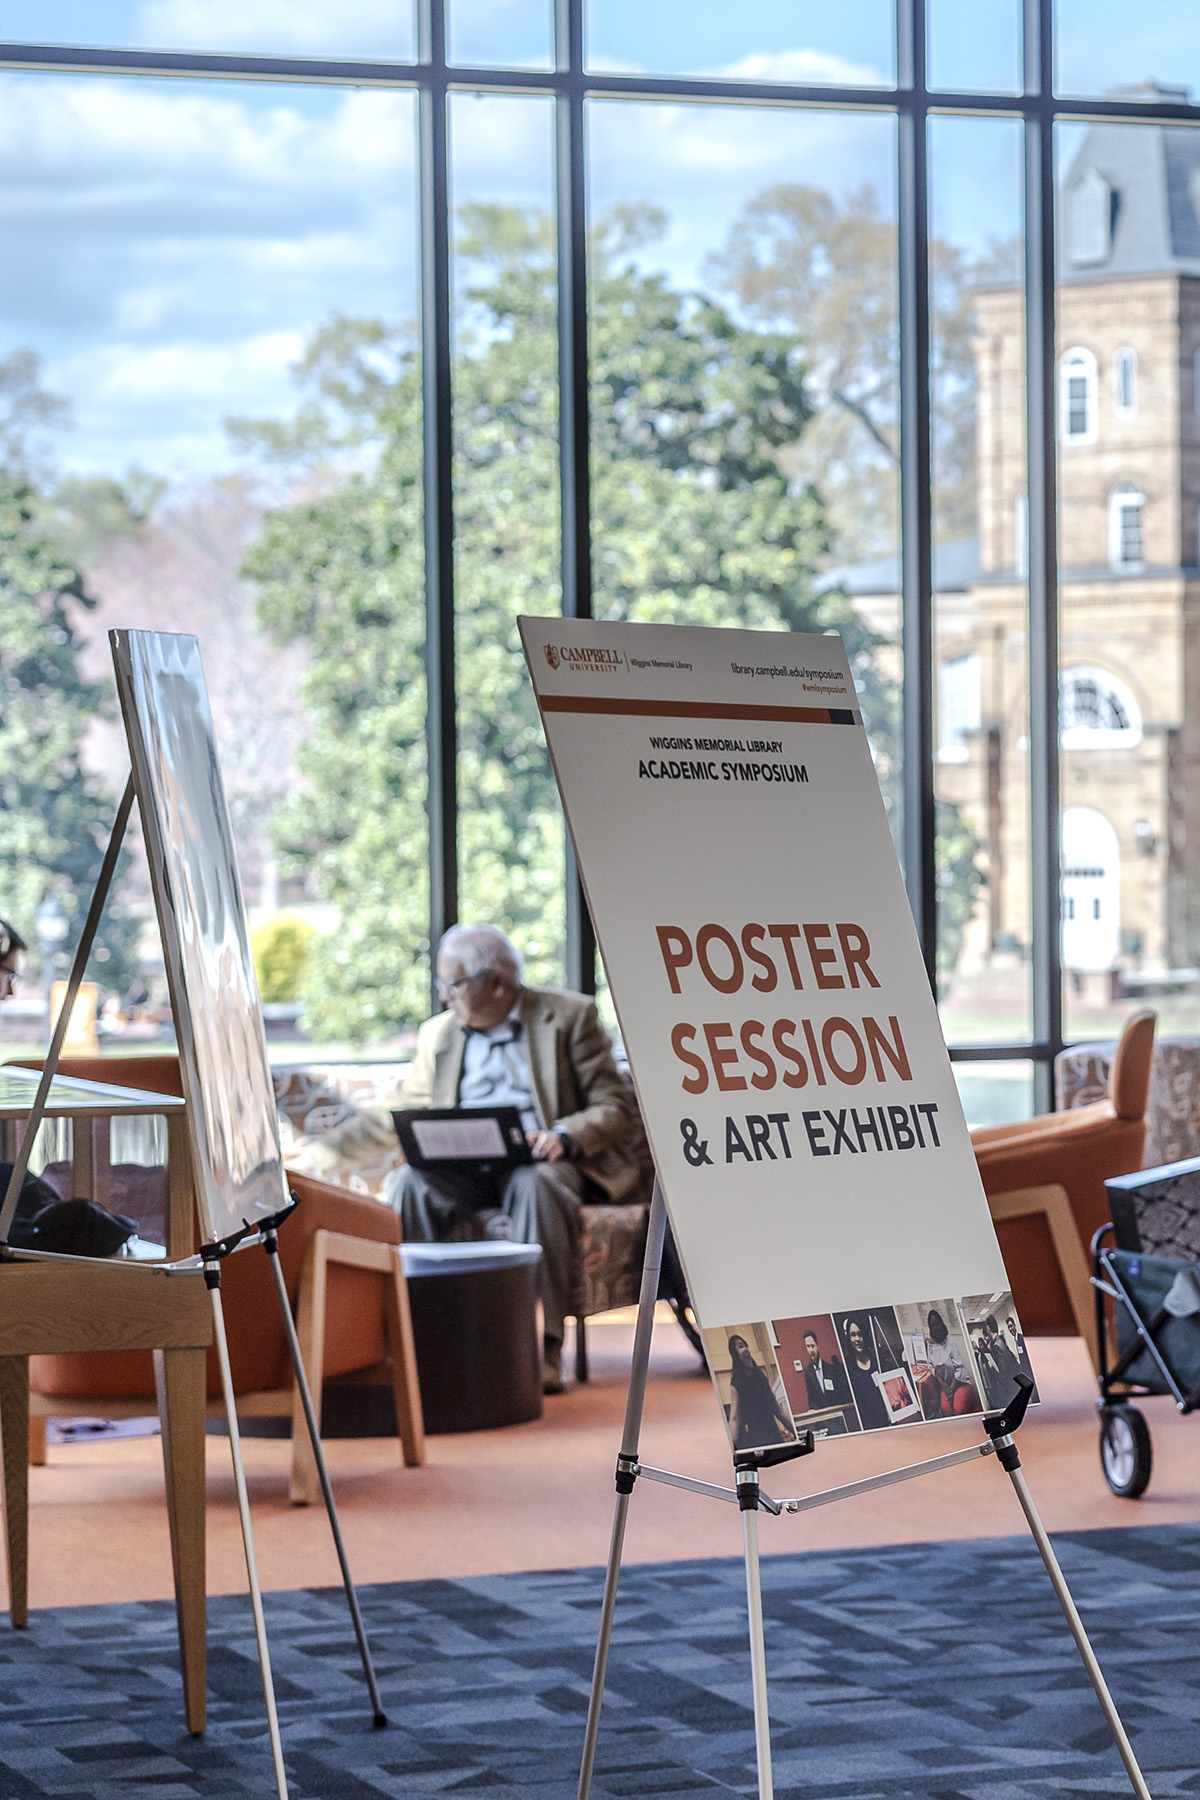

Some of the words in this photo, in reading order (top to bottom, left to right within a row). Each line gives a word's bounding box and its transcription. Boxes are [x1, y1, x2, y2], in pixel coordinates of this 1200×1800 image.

[560, 647, 623, 664] CAMPBELL
[630, 658, 651, 669] Wiggins
[651, 659, 675, 668] Memorial
[675, 660, 693, 671] Library
[569, 663, 618, 673] UNIVERSITY
[731, 662, 844, 682] library.campbell.edu/symposium
[649, 737, 693, 750] WIGGINS
[695, 738, 746, 752] MEMORIAL
[747, 740, 783, 753] LIBRARY
[639, 760, 719, 780] ACADEMIC
[721, 762, 809, 783] SYMPOSIUM
[655, 922, 882, 994] POSTER
[670, 1016, 913, 1095] SESSION
[679, 1117, 714, 1167] &
[725, 1112, 793, 1164] ART
[802, 1103, 941, 1157] EXHIBIT
